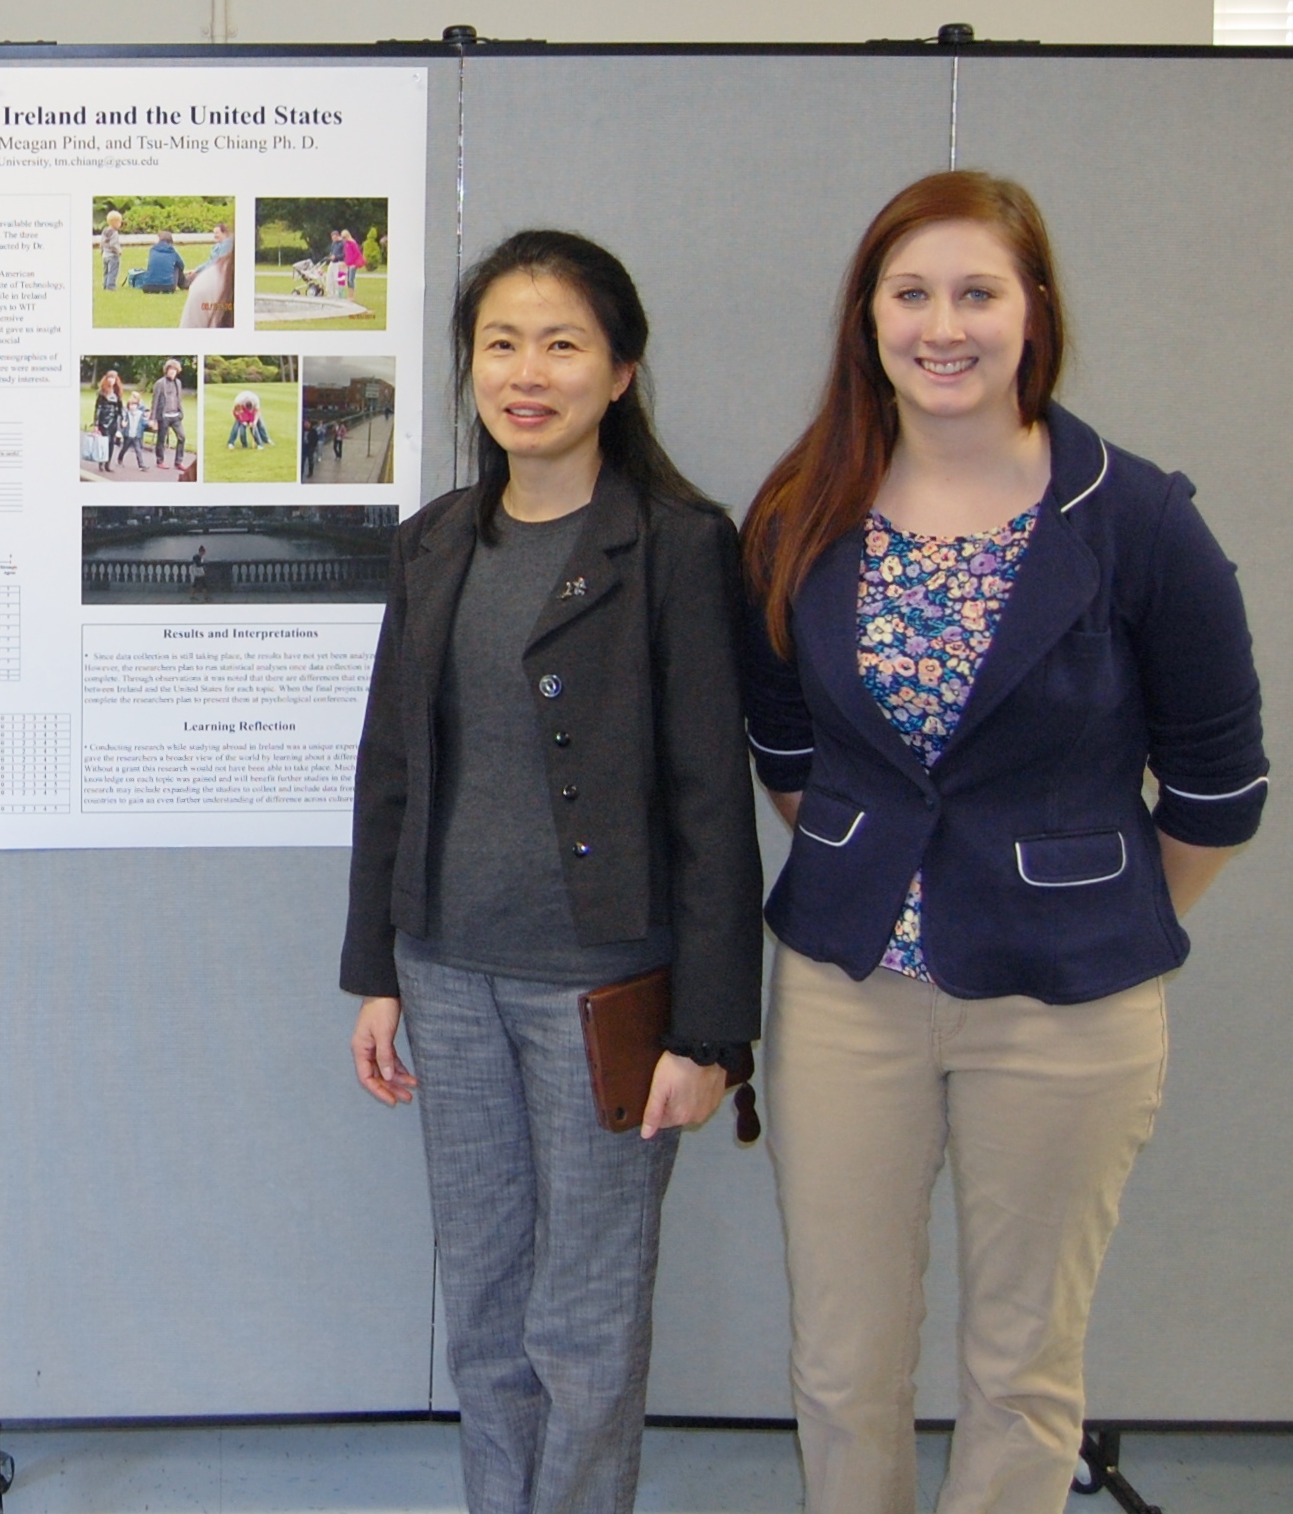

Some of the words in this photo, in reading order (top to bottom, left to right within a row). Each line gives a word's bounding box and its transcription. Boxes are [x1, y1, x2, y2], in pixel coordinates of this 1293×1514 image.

[4, 106, 86, 125] Ireland
[95, 106, 137, 124] and
[146, 106, 181, 124] the
[190, 106, 266, 124] United
[274, 106, 342, 125] States
[62, 136, 100, 150] Pind,
[105, 136, 132, 149] and
[137, 136, 210, 153] Tsu-Ming
[214, 136, 268, 153] Chiang
[273, 135, 295, 149] Ph.
[301, 136, 318, 149] D.
[54, 157, 159, 168] tm.chiang@gcsu.edu
[163, 629, 204, 638] Results
[207, 629, 229, 638] and
[232, 629, 318, 638] Interpretations
[195, 652, 219, 661] taking
[220, 653, 242, 661] place,
[257, 652, 282, 660] results
[316, 653, 329, 661] yet
[84, 664, 120, 672] However,
[177, 664, 195, 672] plan
[256, 663, 288, 672] analyses
[183, 722, 236, 732] Learning
[239, 721, 296, 731] Reflection
